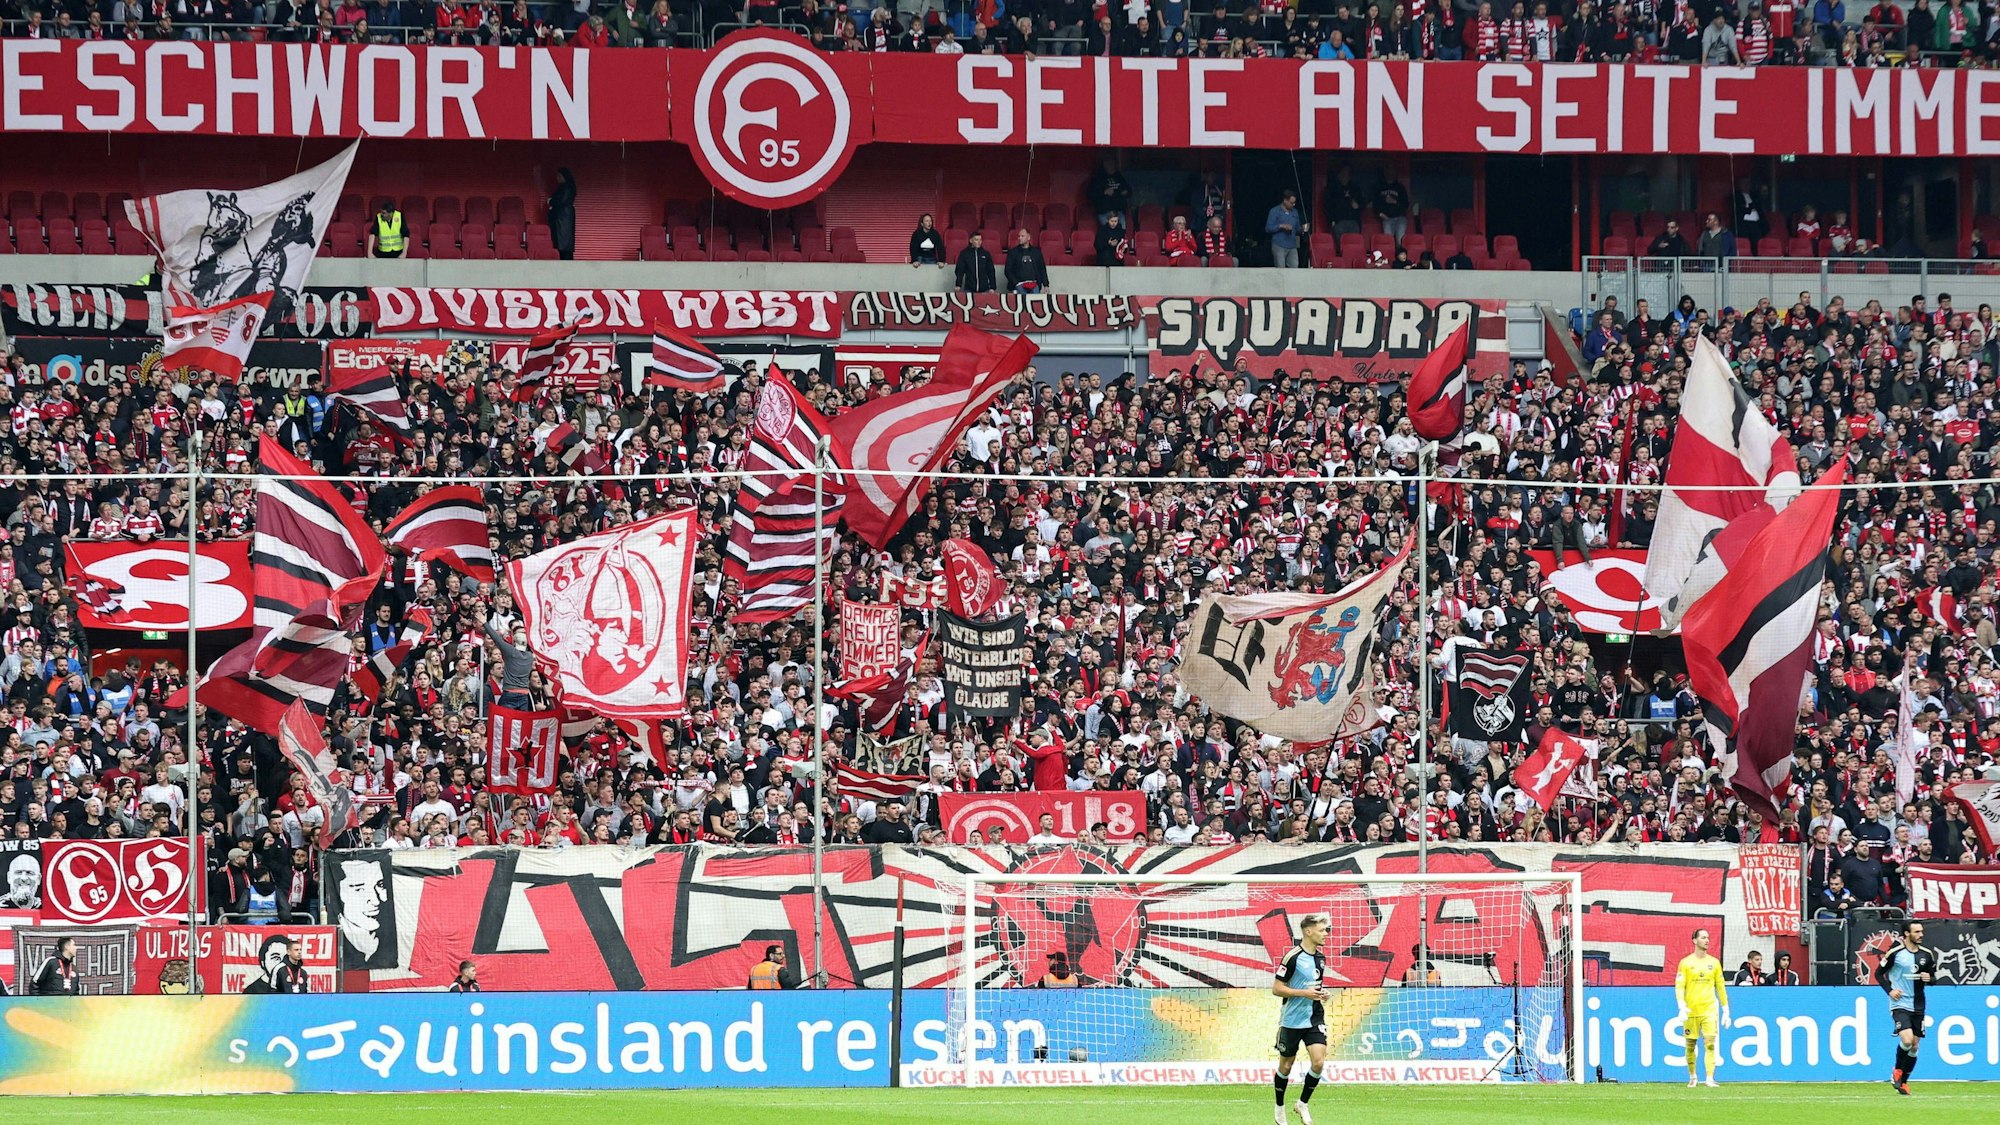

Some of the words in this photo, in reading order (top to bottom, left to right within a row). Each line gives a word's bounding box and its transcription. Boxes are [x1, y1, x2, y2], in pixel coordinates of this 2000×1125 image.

[2, 38, 590, 140] ESCHWOR'N
[956, 53, 1245, 147] SEITE
[1298, 59, 1424, 150] AN
[1475, 62, 1756, 154] SEITE
[758, 139, 801, 168] 95
[14, 283, 127, 331] RED
[371, 286, 645, 330] DIVISION
[662, 290, 838, 333] WEST
[1000, 293, 1134, 328] YOUTH
[844, 604, 898, 624] DAMALS
[844, 620, 896, 645] HEUTE
[946, 622, 980, 646] WIR
[982, 628, 1015, 647] SIND
[844, 640, 896, 664] IMMER
[945, 663, 972, 687] WIE
[975, 669, 1021, 688] UNSER
[955, 688, 1010, 709] GLAUBE
[22, 839, 40, 851] 85
[89, 885, 109, 905] 95
[226, 973, 246, 993] WE
[908, 1066, 994, 1085] KÜCHN
[1002, 1068, 1093, 1084] AKTUELL
[1111, 1065, 1196, 1083] KÜCHEN
[1404, 1066, 1494, 1082] AKTUELL
